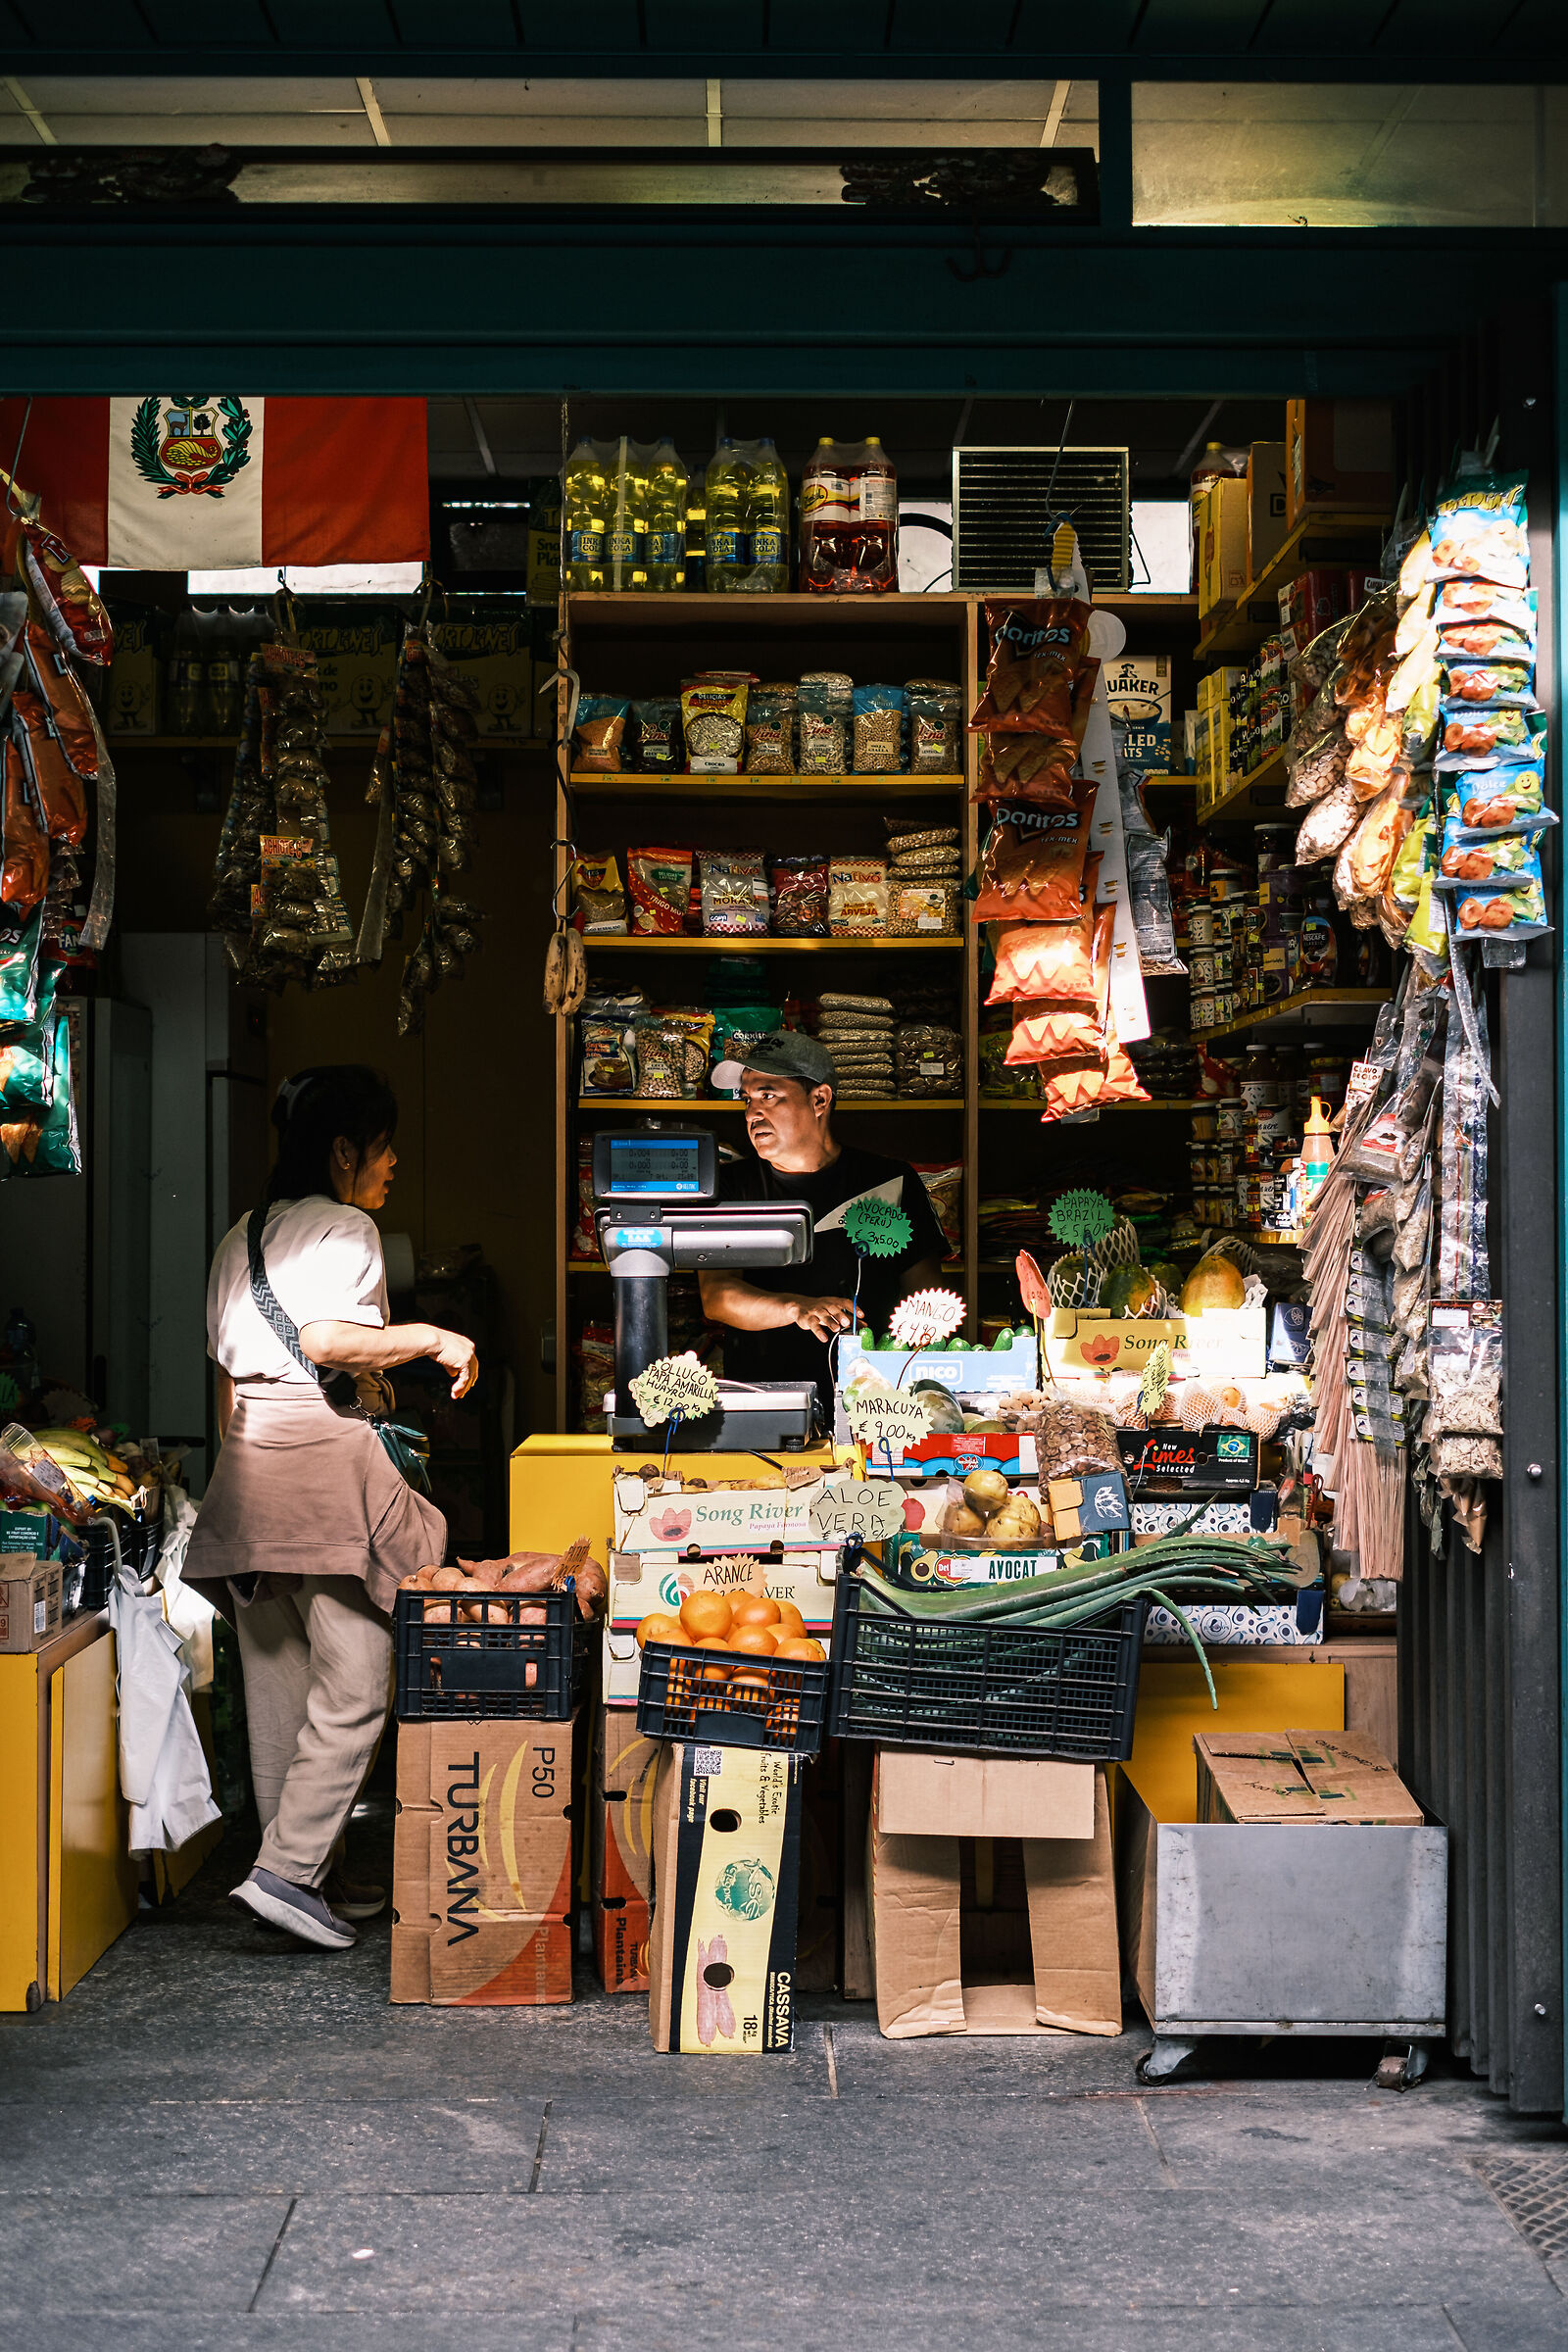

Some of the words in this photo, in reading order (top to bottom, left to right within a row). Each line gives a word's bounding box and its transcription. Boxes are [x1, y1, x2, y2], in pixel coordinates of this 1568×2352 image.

[996, 625, 1071, 646] Doritos
[1107, 679, 1159, 696] UAKER
[1472, 780, 1507, 795] Dolce
[997, 808, 1079, 829] Doritos
[649, 895, 670, 910] TRIGO
[840, 907, 879, 917] ARVEJA
[856, 1201, 904, 1221] AVOCADO
[1061, 1196, 1104, 1209] PAPAYA
[1056, 1208, 1105, 1222] BRAZIL
[855, 1229, 863, 1241] €
[648, 1365, 670, 1386] PAPA
[671, 1378, 714, 1400] AMARILLA
[661, 1362, 708, 1386] OLLUCO
[646, 1377, 686, 1398] HUAYRO
[653, 1394, 661, 1404] €
[856, 1397, 924, 1419] MARACUYA
[858, 1420, 868, 1433] €
[1155, 1464, 1196, 1474] Selected
[816, 1488, 893, 1507] ALOE
[696, 1504, 745, 1527] Song
[749, 1502, 804, 1520] River
[816, 1512, 886, 1532] VERA
[749, 1522, 775, 1531] Papaya
[703, 1563, 755, 1586] ARANCE
[988, 1559, 1038, 1580] AVOCAT
[763, 1587, 795, 1599] VER
[531, 1746, 556, 1798] P50
[771, 1761, 784, 1789] World's
[757, 1785, 770, 1825] Vegetables
[770, 1791, 782, 1816] Exotic
[686, 1806, 696, 1824] page
[446, 1750, 480, 1947] TURBANA
[775, 1971, 792, 2048] CASSAVA
[743, 2014, 759, 2031] 18
